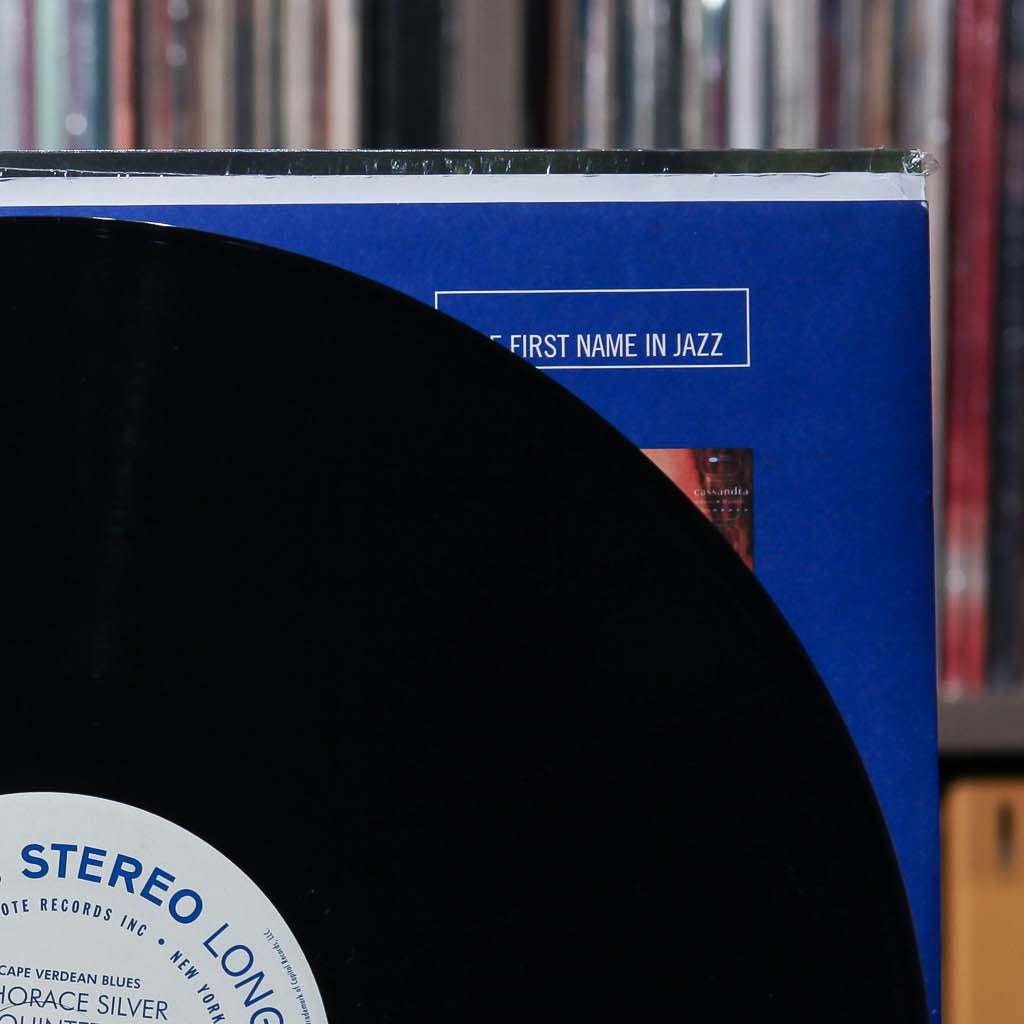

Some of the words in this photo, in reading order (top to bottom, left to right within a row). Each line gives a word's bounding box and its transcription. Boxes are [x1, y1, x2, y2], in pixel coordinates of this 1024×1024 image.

[510, 334, 570, 358] FIRST
[577, 333, 638, 358] NAME
[646, 333, 667, 357] IN
[673, 332, 724, 357] JAZZ
[21, 843, 204, 924] STEREO
[40, 898, 113, 921] RECORDS
[120, 914, 149, 937] INC
[169, 950, 200, 980] NEW
[197, 984, 226, 1024] YORK
[35, 968, 97, 985] VERDEAN
[102, 974, 141, 989] BLUES
[97, 994, 168, 1020] SILVER
